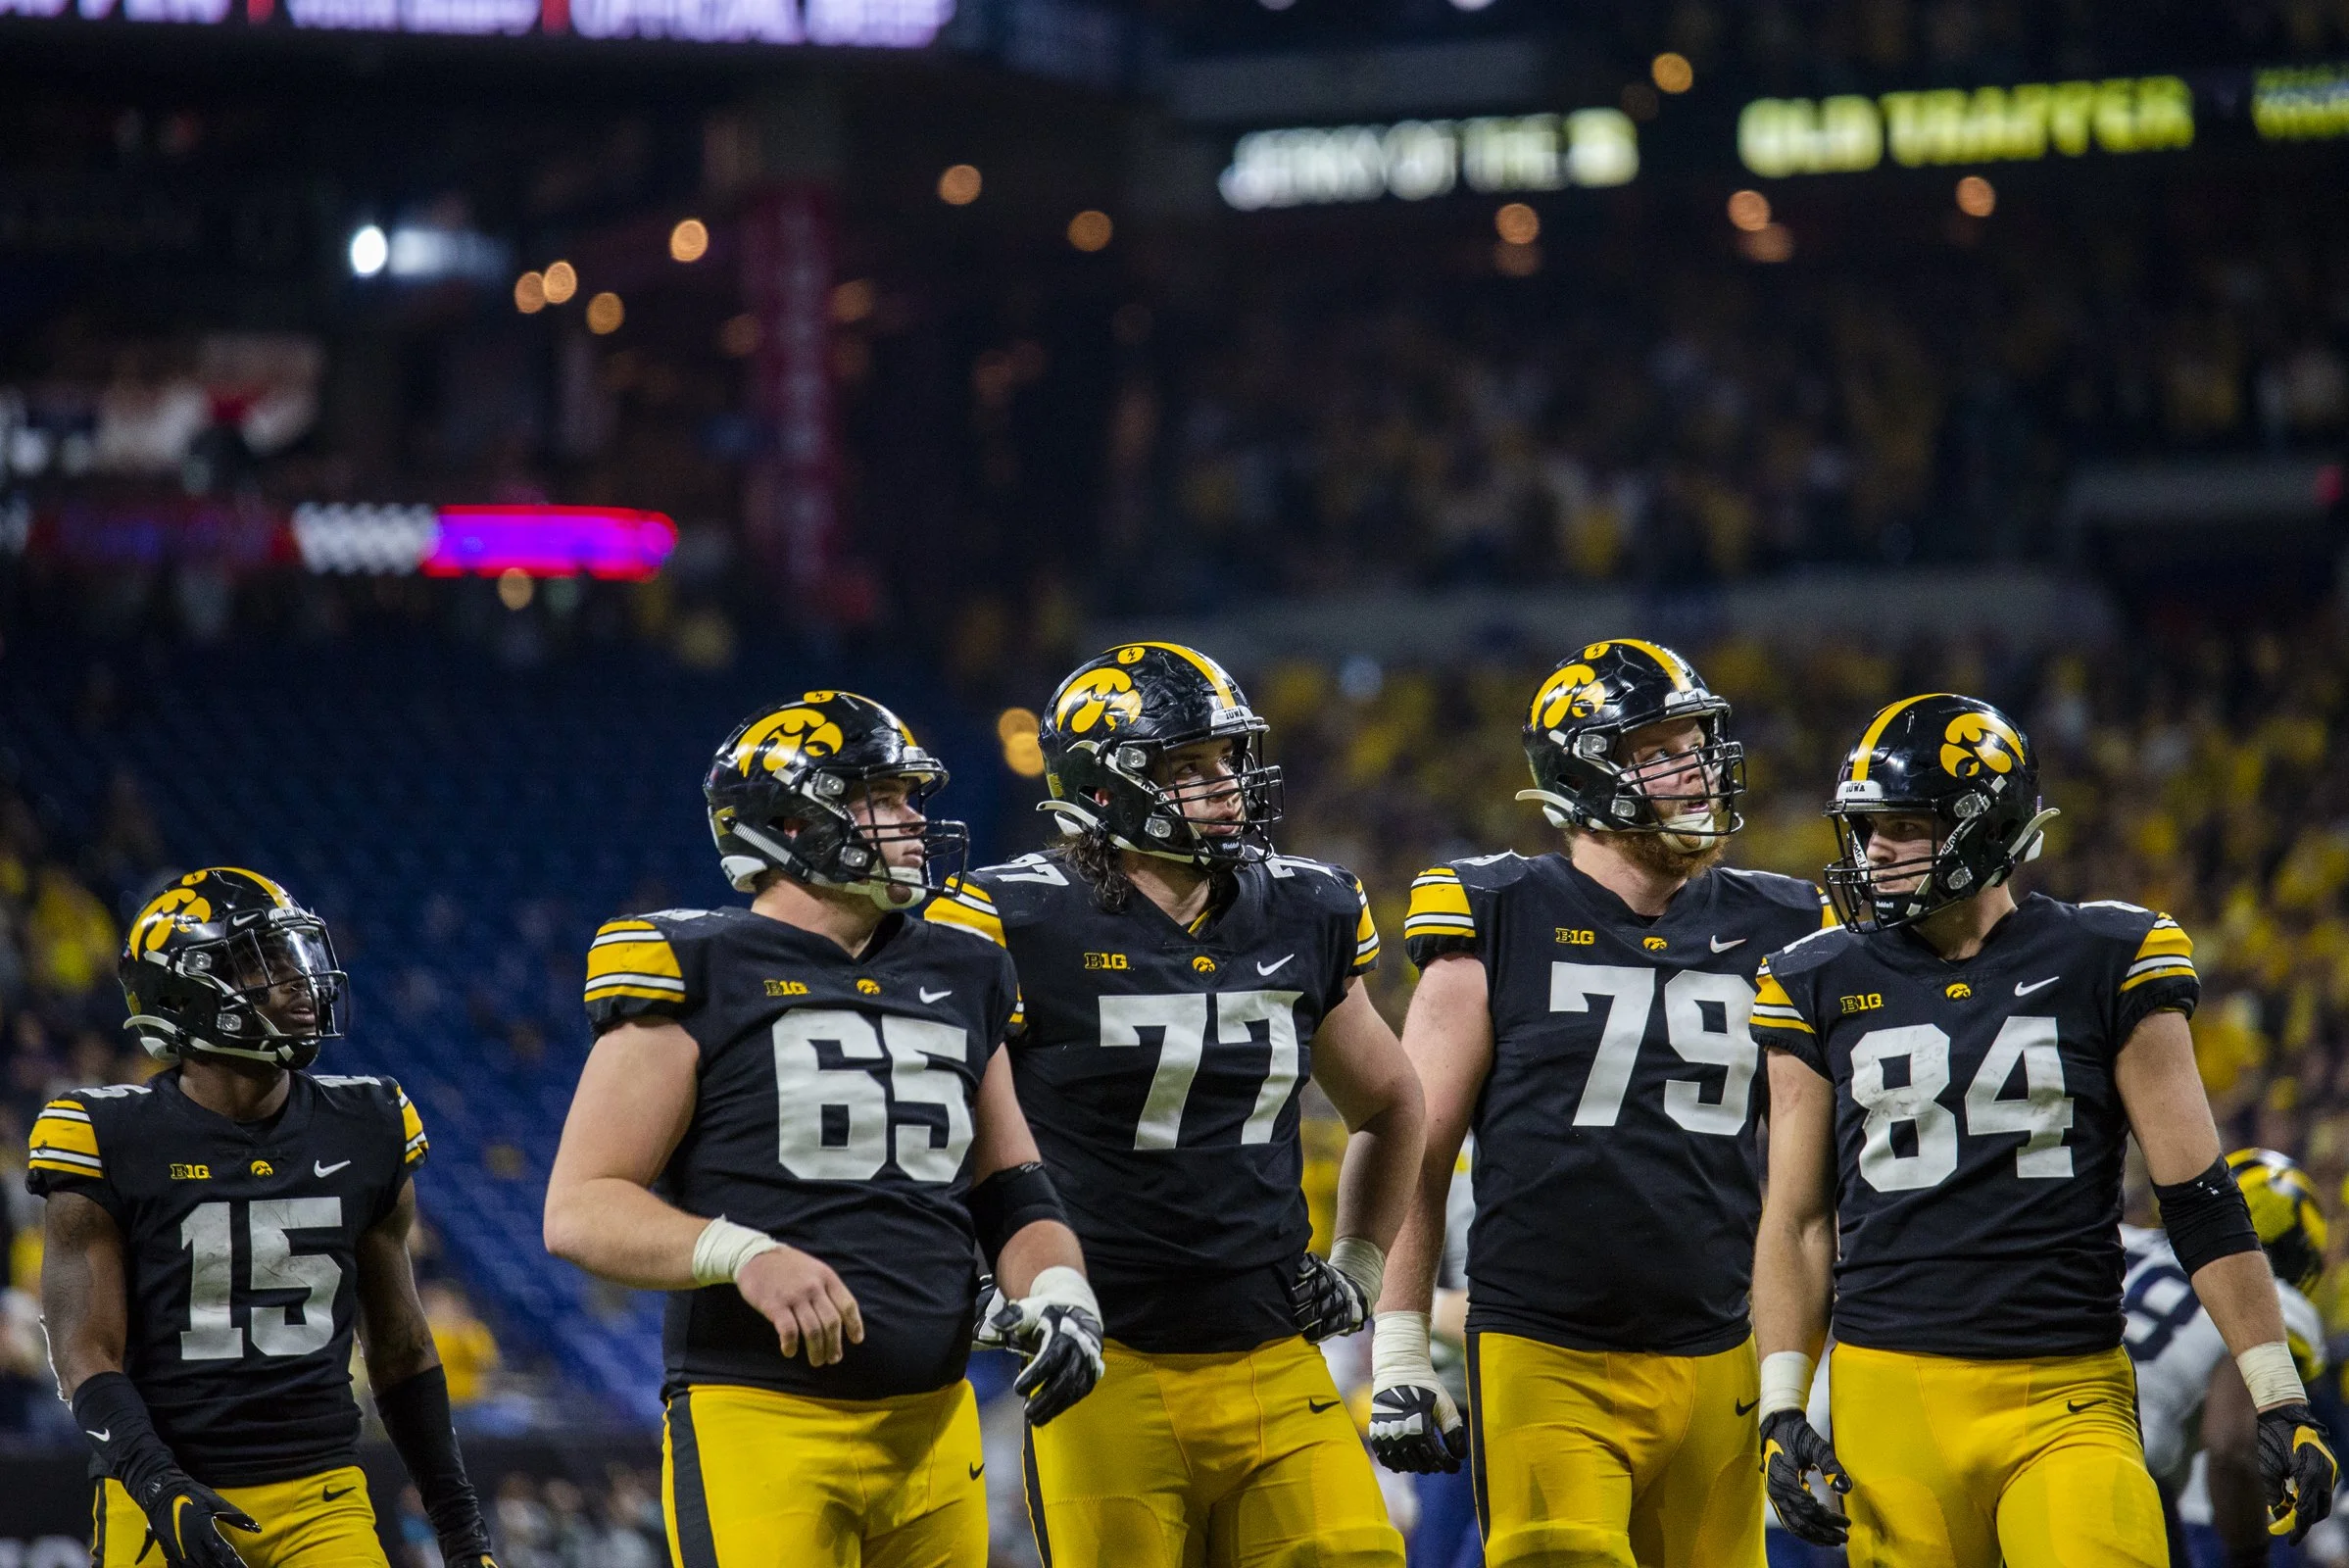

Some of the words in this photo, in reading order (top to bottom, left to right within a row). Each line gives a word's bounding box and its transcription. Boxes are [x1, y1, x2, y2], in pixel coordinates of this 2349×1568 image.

[772, 1007, 974, 1184] 65
[1099, 990, 1304, 1151] 77
[1549, 961, 1760, 1137] 79
[1849, 1015, 2075, 1193] 84
[179, 1196, 343, 1361] 15
